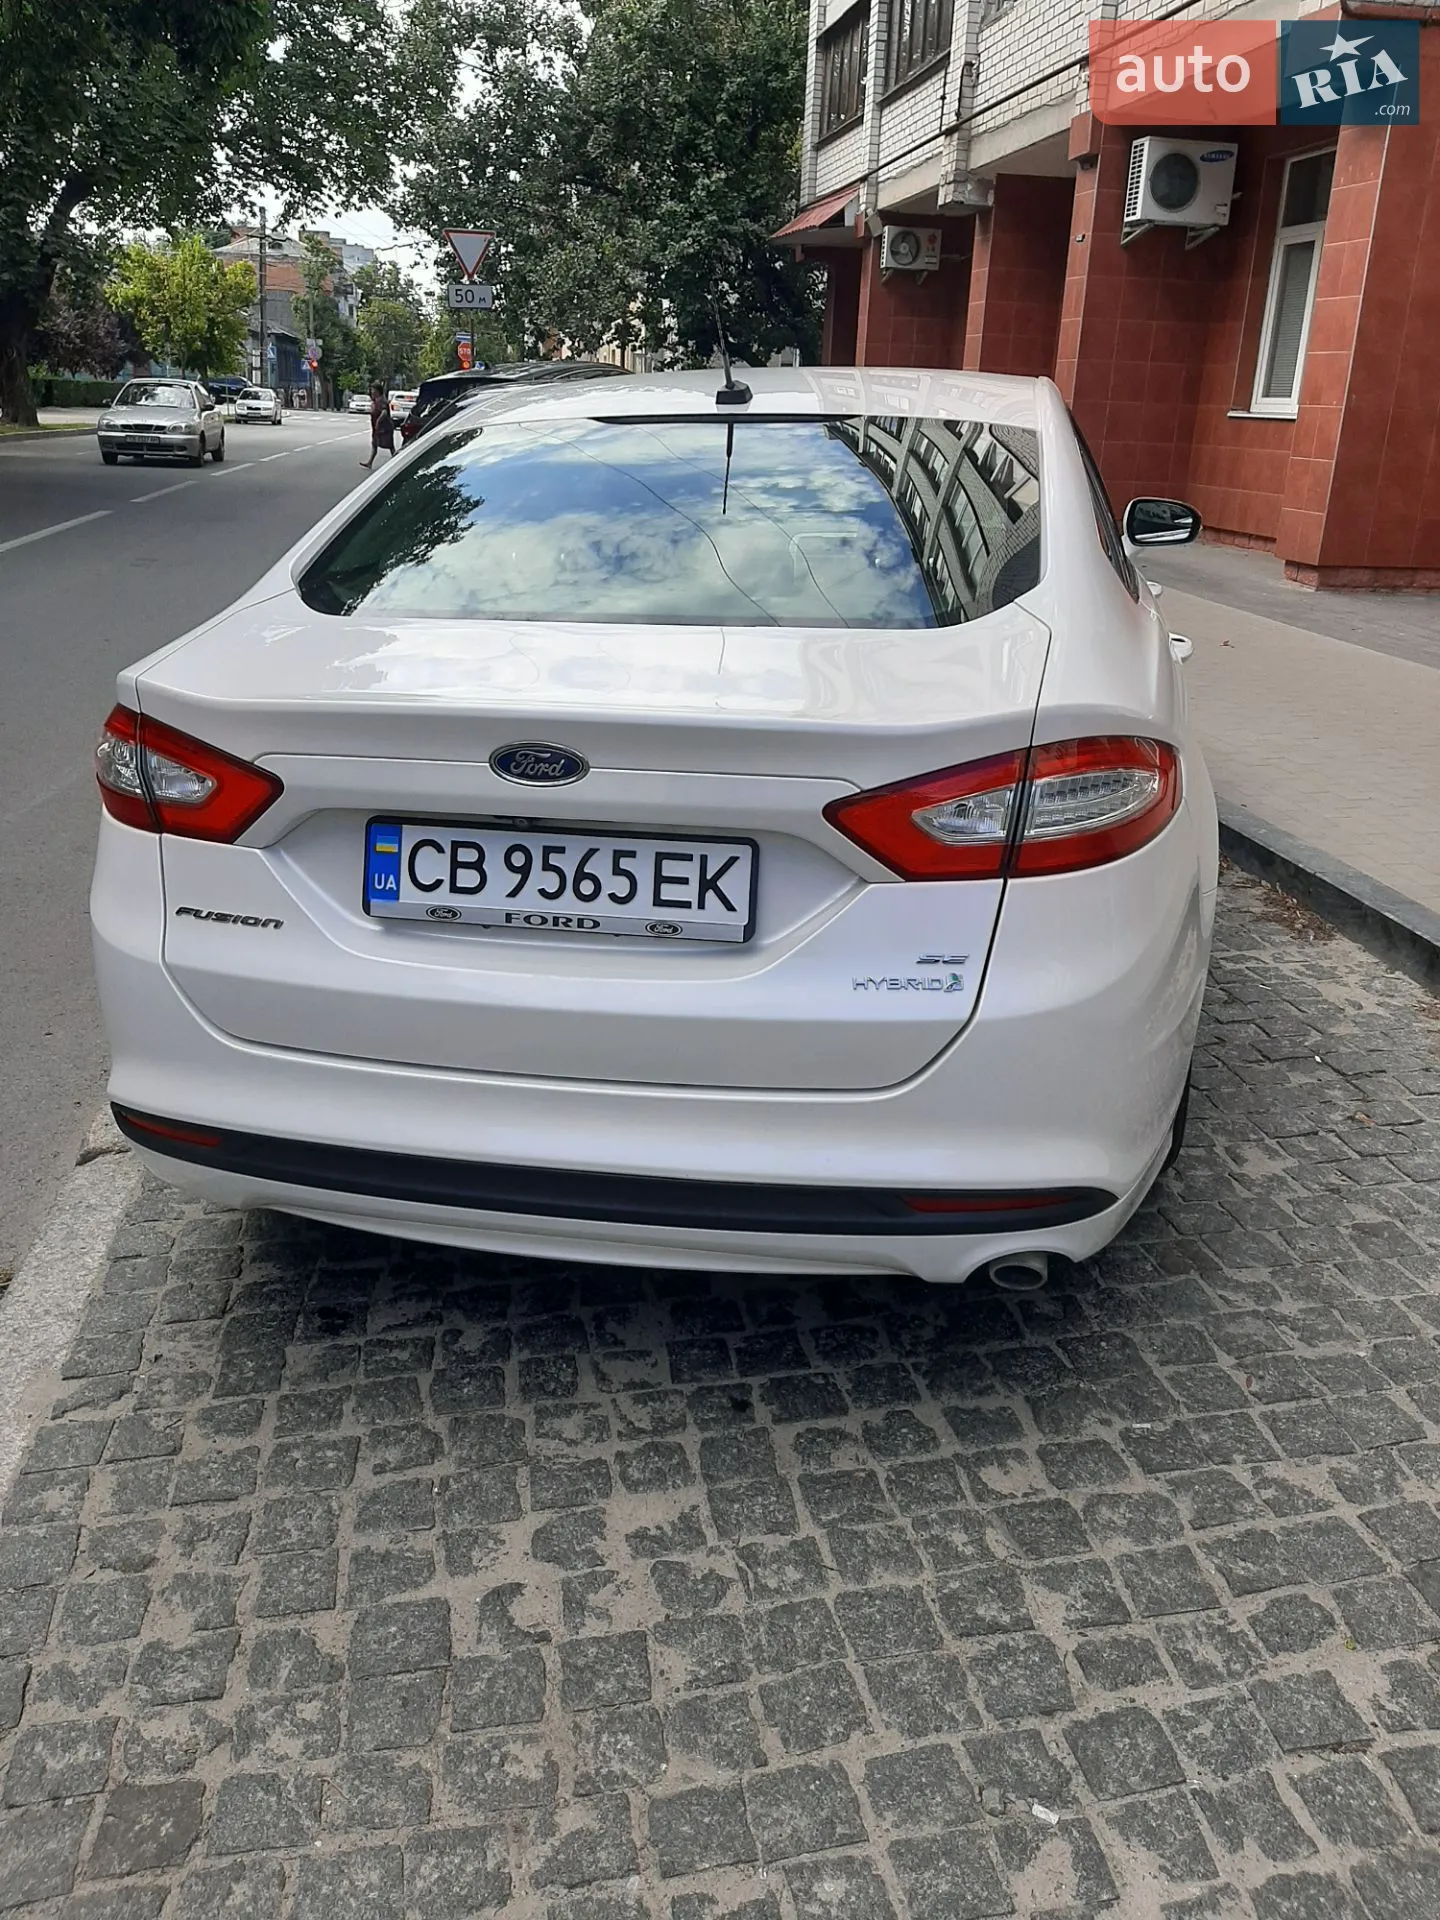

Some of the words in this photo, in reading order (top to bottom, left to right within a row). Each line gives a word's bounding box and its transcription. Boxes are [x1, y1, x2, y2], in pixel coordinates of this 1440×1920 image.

[455, 289, 475, 303] 50
[510, 750, 565, 777] Ford
[374, 873, 397, 891] UA
[407, 838, 488, 895] CB
[503, 843, 638, 905] 9565
[652, 851, 741, 912] EK
[175, 906, 285, 930] FUSION
[504, 912, 601, 930] FORD
[916, 953, 969, 964] SE
[852, 975, 944, 991] HYBRID
